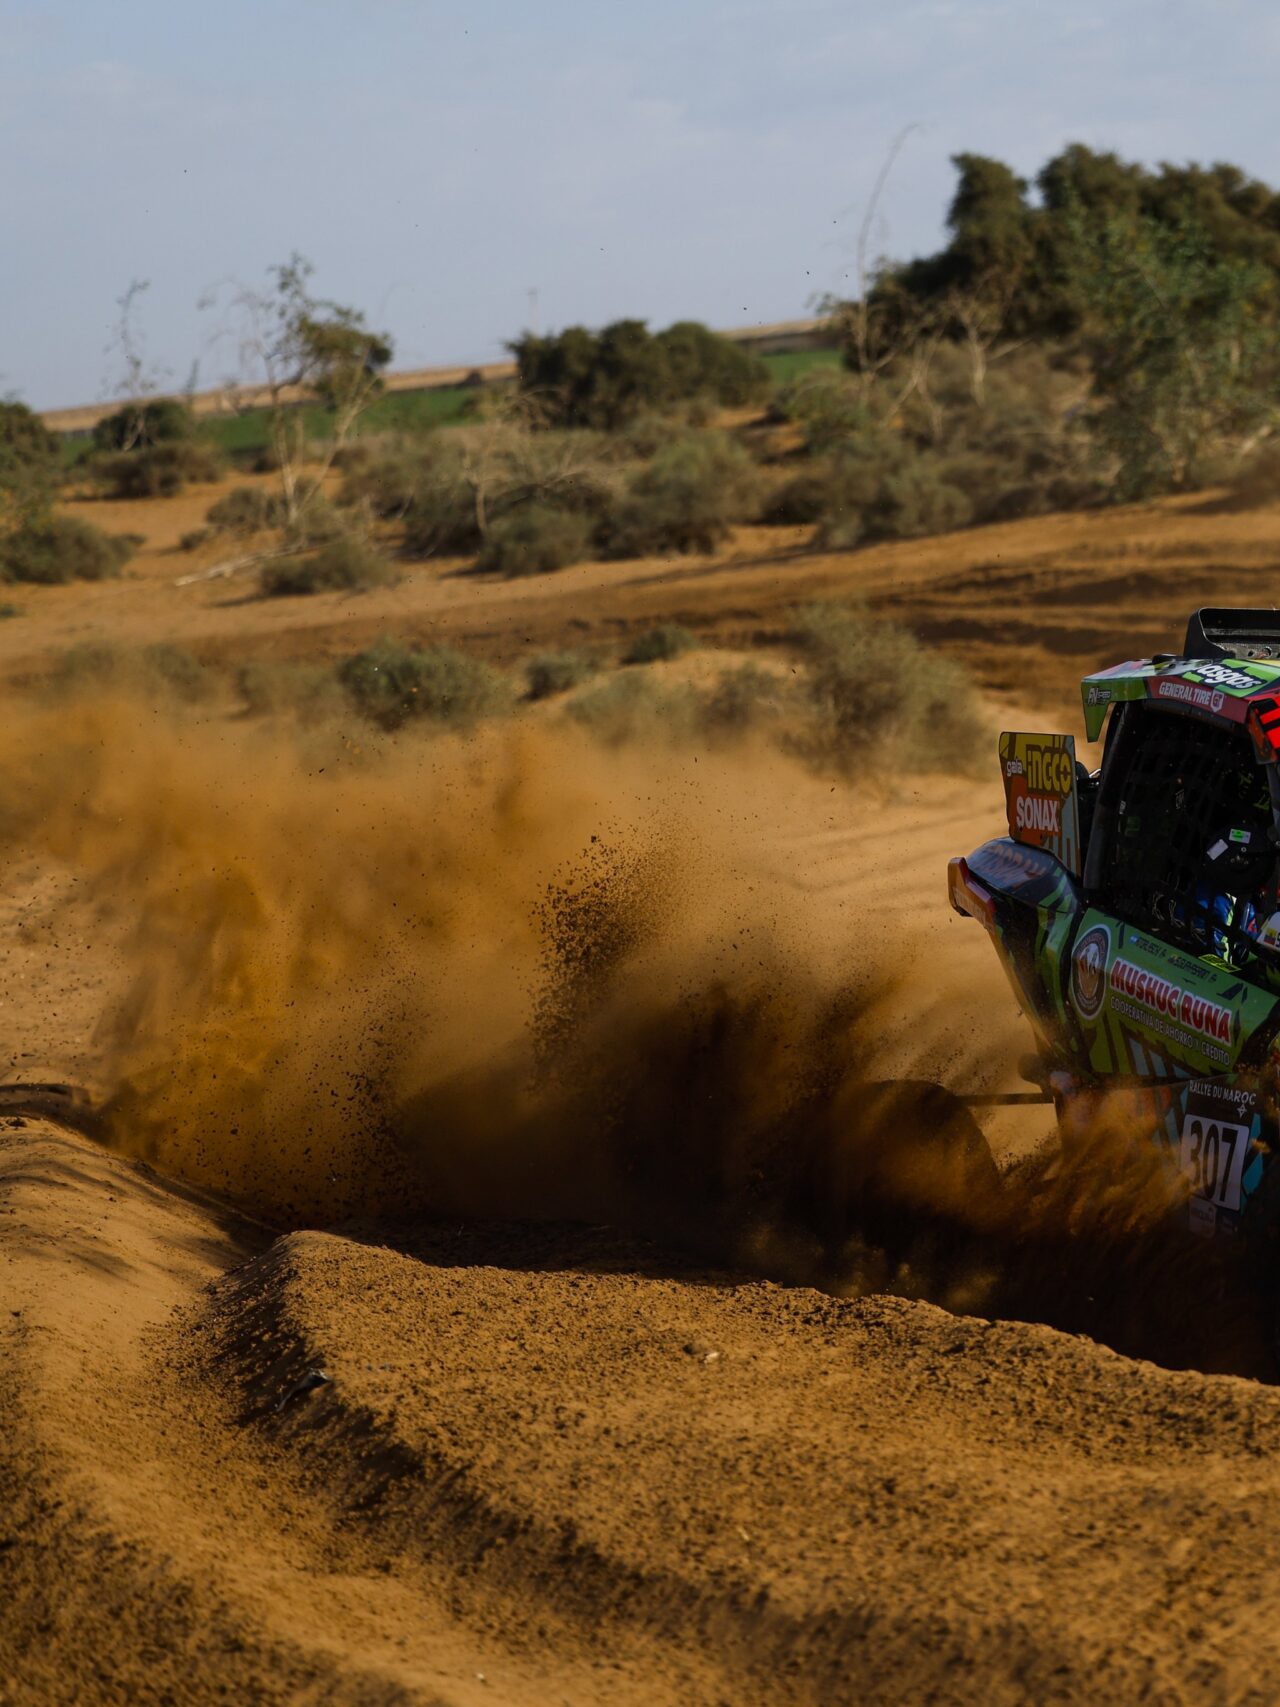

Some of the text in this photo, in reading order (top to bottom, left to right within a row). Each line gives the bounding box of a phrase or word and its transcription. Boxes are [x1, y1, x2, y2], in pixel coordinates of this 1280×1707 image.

[1195, 663, 1262, 689] asgas
[1158, 681, 1193, 701] GENERAL
[1193, 688, 1212, 705] TIRE
[1016, 796, 1060, 833] SONAX
[1110, 957, 1182, 1021] MUSHUC
[1180, 990, 1233, 1048] RUNA
[1200, 1041, 1231, 1065] CREDITO
[1189, 1079, 1257, 1106] RALLYE DU MAROC
[1189, 1119, 1239, 1203] 307
